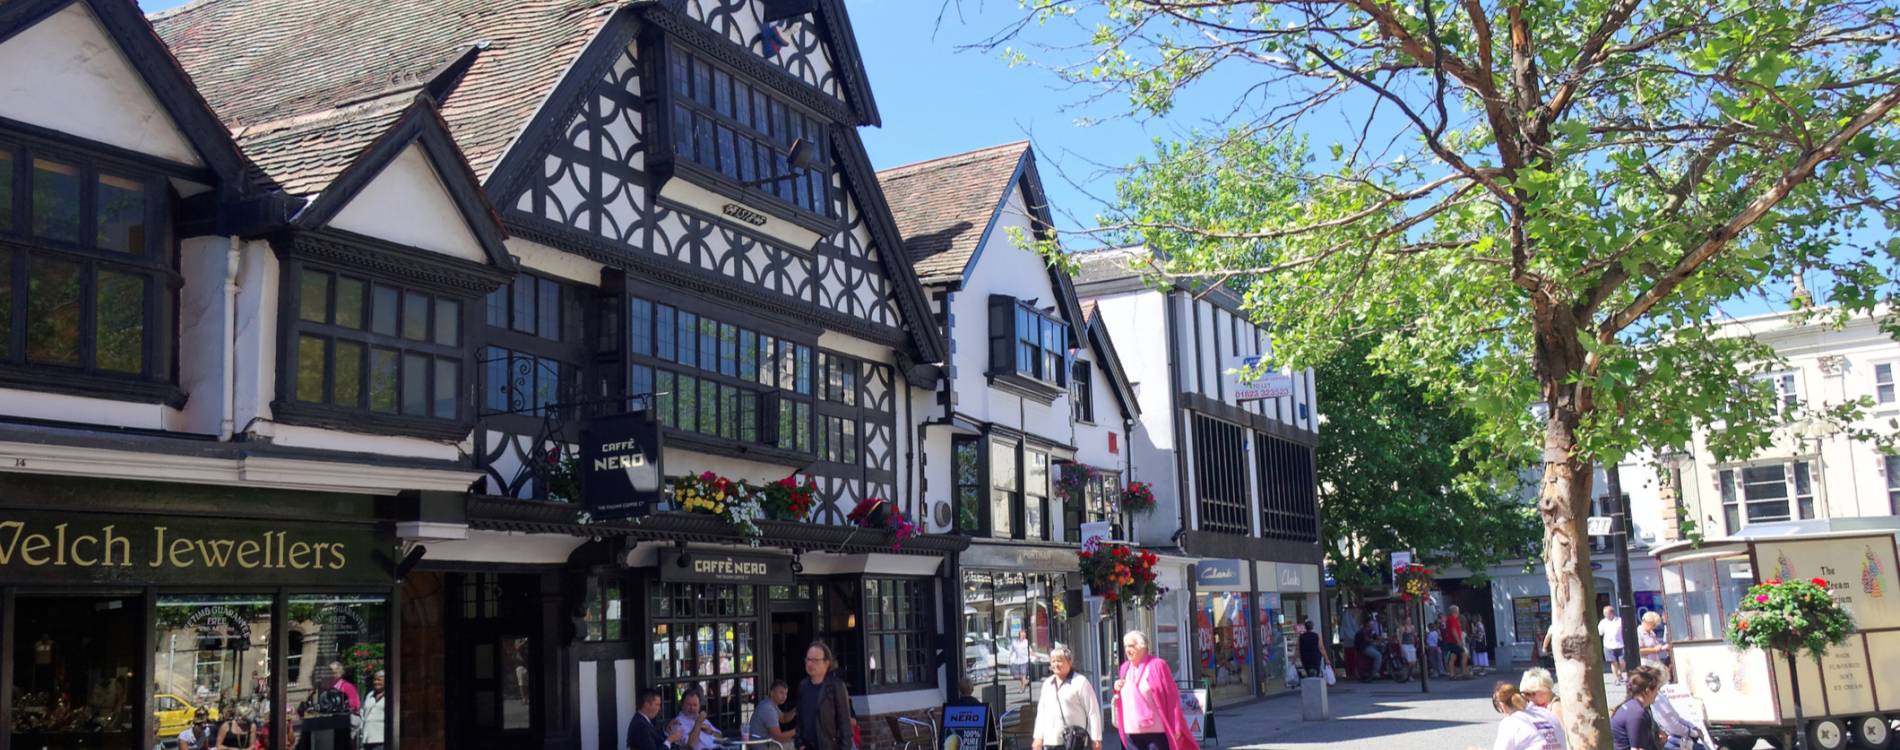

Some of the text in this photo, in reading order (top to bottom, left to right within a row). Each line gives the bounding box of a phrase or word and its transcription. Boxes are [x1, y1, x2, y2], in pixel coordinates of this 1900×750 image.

[602, 438, 634, 452] CAFFÈ
[594, 453, 644, 471] NERO
[149, 526, 346, 569] Jewellers
[695, 557, 767, 575] CAFFÈ NERO
[1821, 566, 1835, 576] The
[951, 714, 979, 722] NERO
